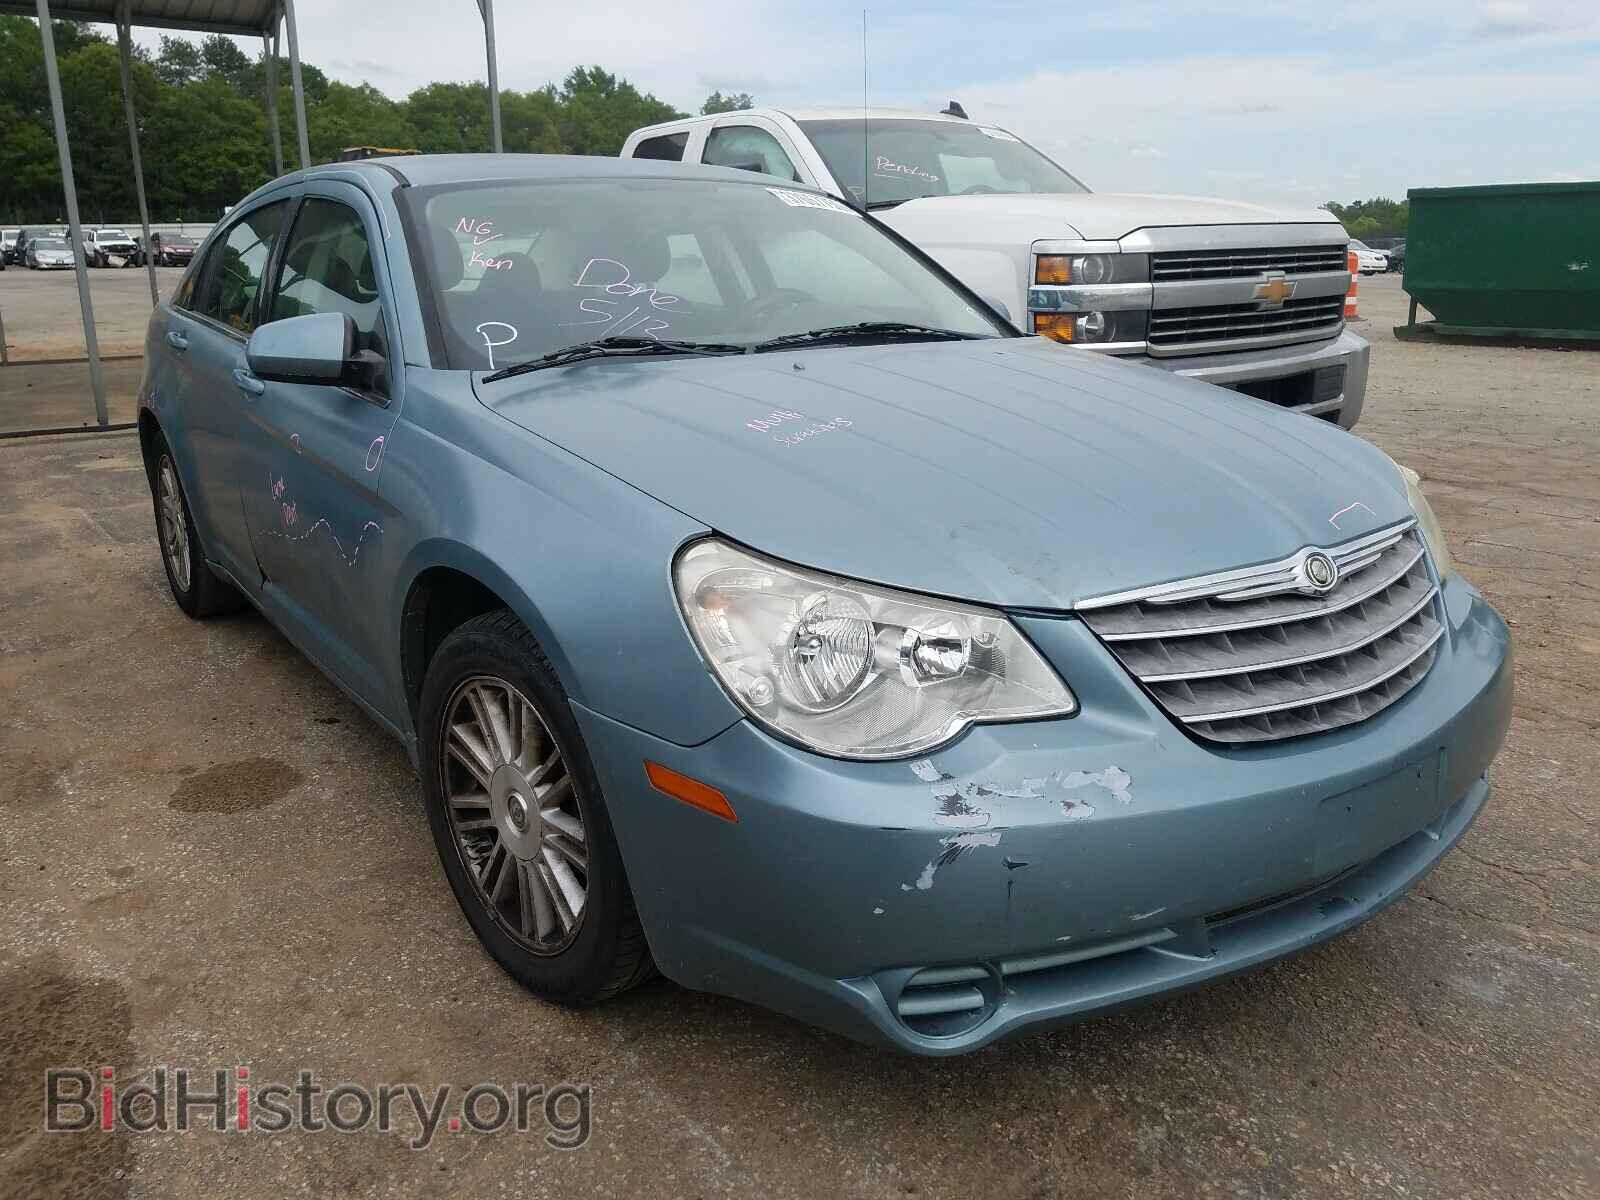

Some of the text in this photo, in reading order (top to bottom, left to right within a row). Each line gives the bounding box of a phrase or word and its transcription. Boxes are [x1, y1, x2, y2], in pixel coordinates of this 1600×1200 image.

[468, 250, 513, 271] Ken
[573, 257, 693, 314] Done
[476, 321, 518, 370] P
